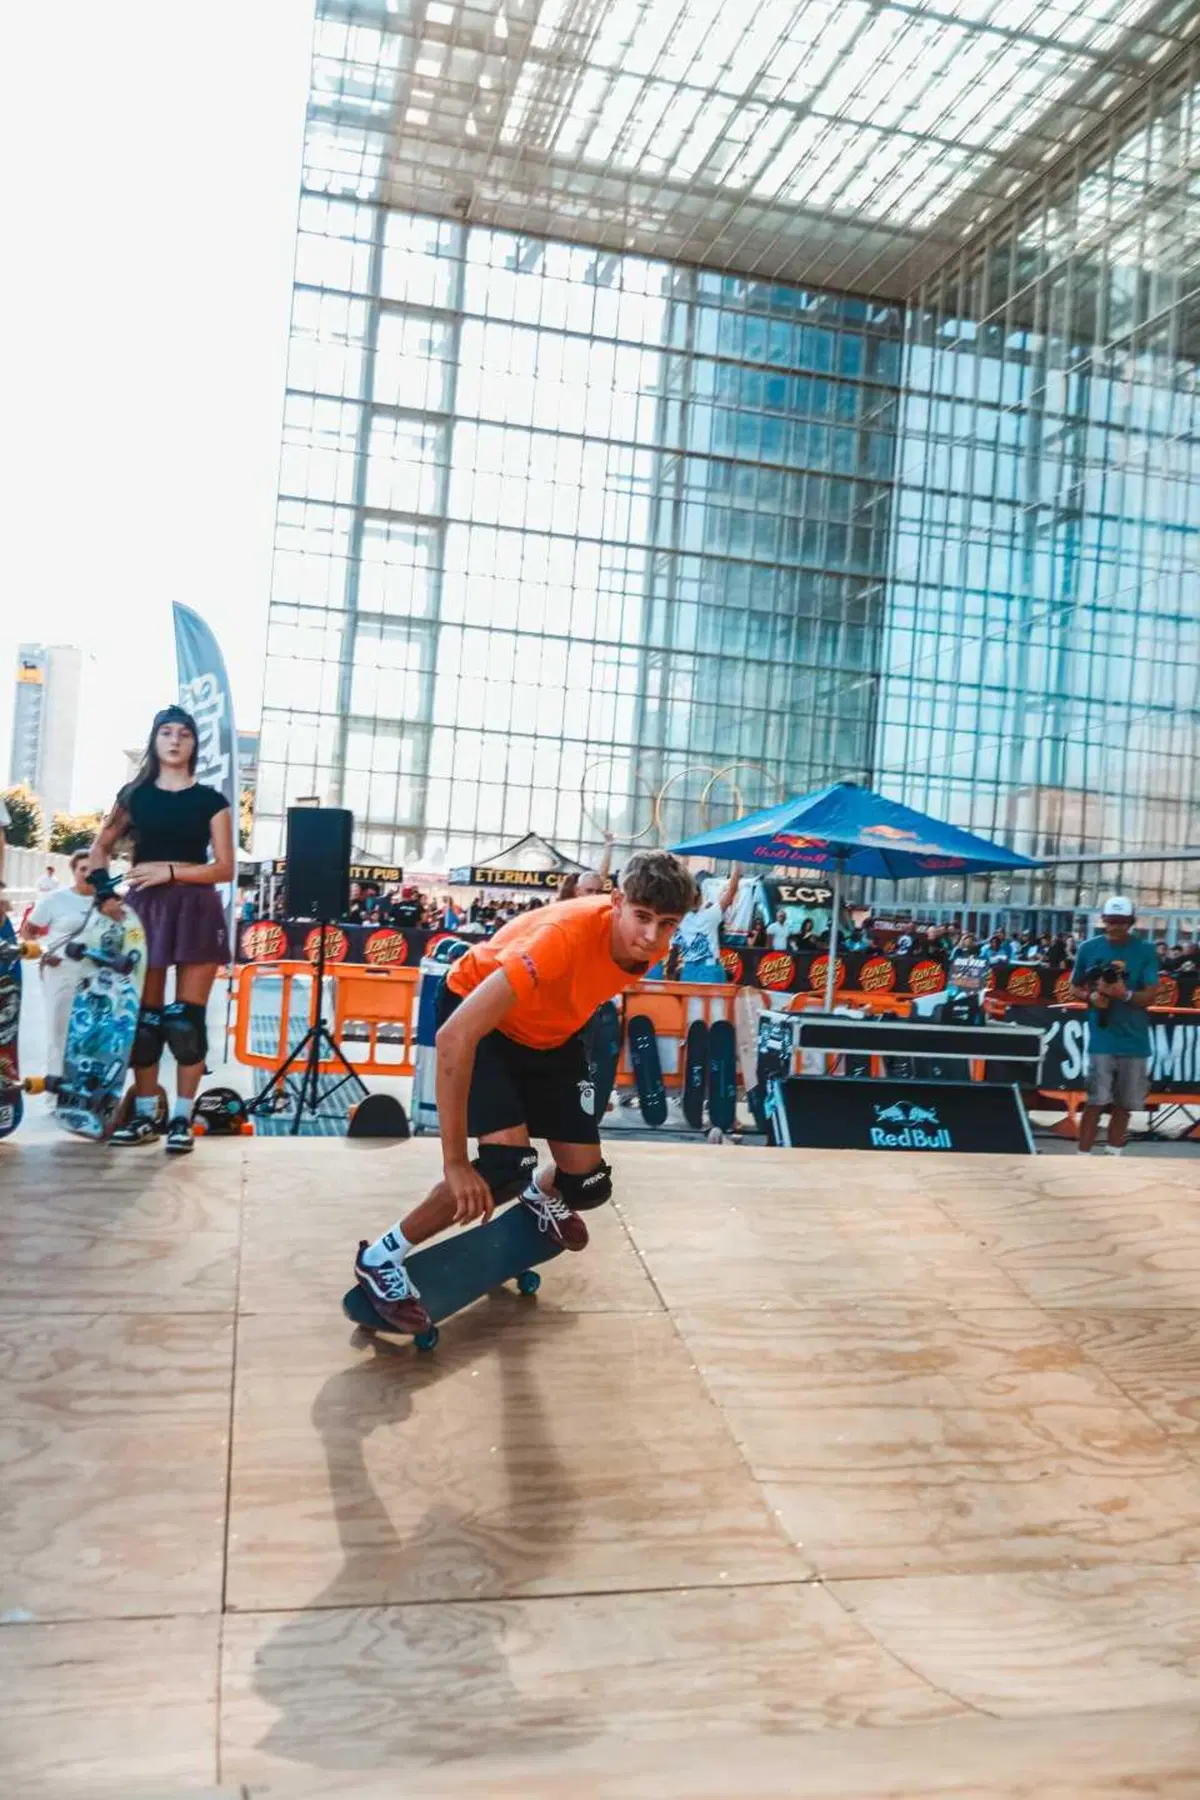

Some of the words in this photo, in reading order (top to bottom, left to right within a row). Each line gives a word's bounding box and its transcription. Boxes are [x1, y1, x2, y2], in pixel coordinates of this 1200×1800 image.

[372, 867, 399, 881] PUB
[475, 868, 543, 885] ETERNAL
[777, 885, 832, 904] ECP
[869, 1127, 912, 1147] Red
[911, 1128, 953, 1149] Bull
